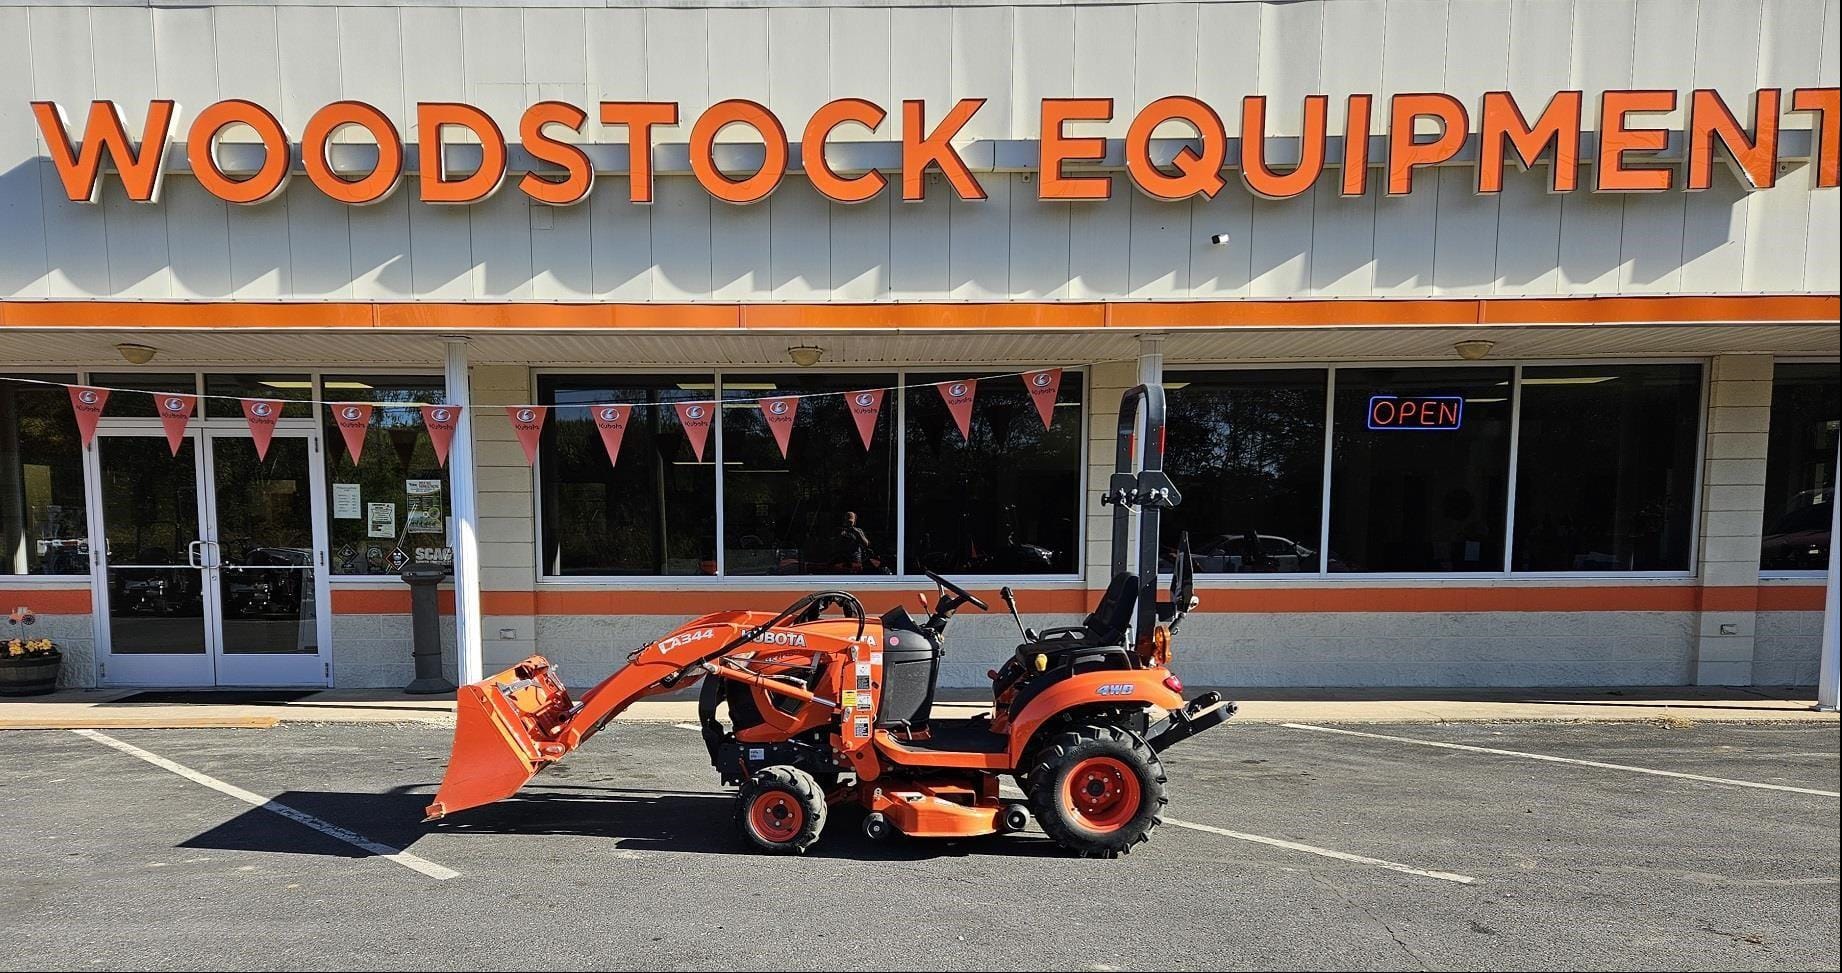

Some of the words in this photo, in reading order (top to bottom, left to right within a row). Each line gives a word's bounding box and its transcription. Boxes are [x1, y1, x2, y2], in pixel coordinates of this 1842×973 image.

[30, 98, 988, 205] WOODSTOCK
[1037, 88, 1841, 203] EQUIPMENT
[1373, 401, 1458, 425] OPEN
[658, 628, 714, 655] LA344
[1096, 684, 1136, 696] 4WD
